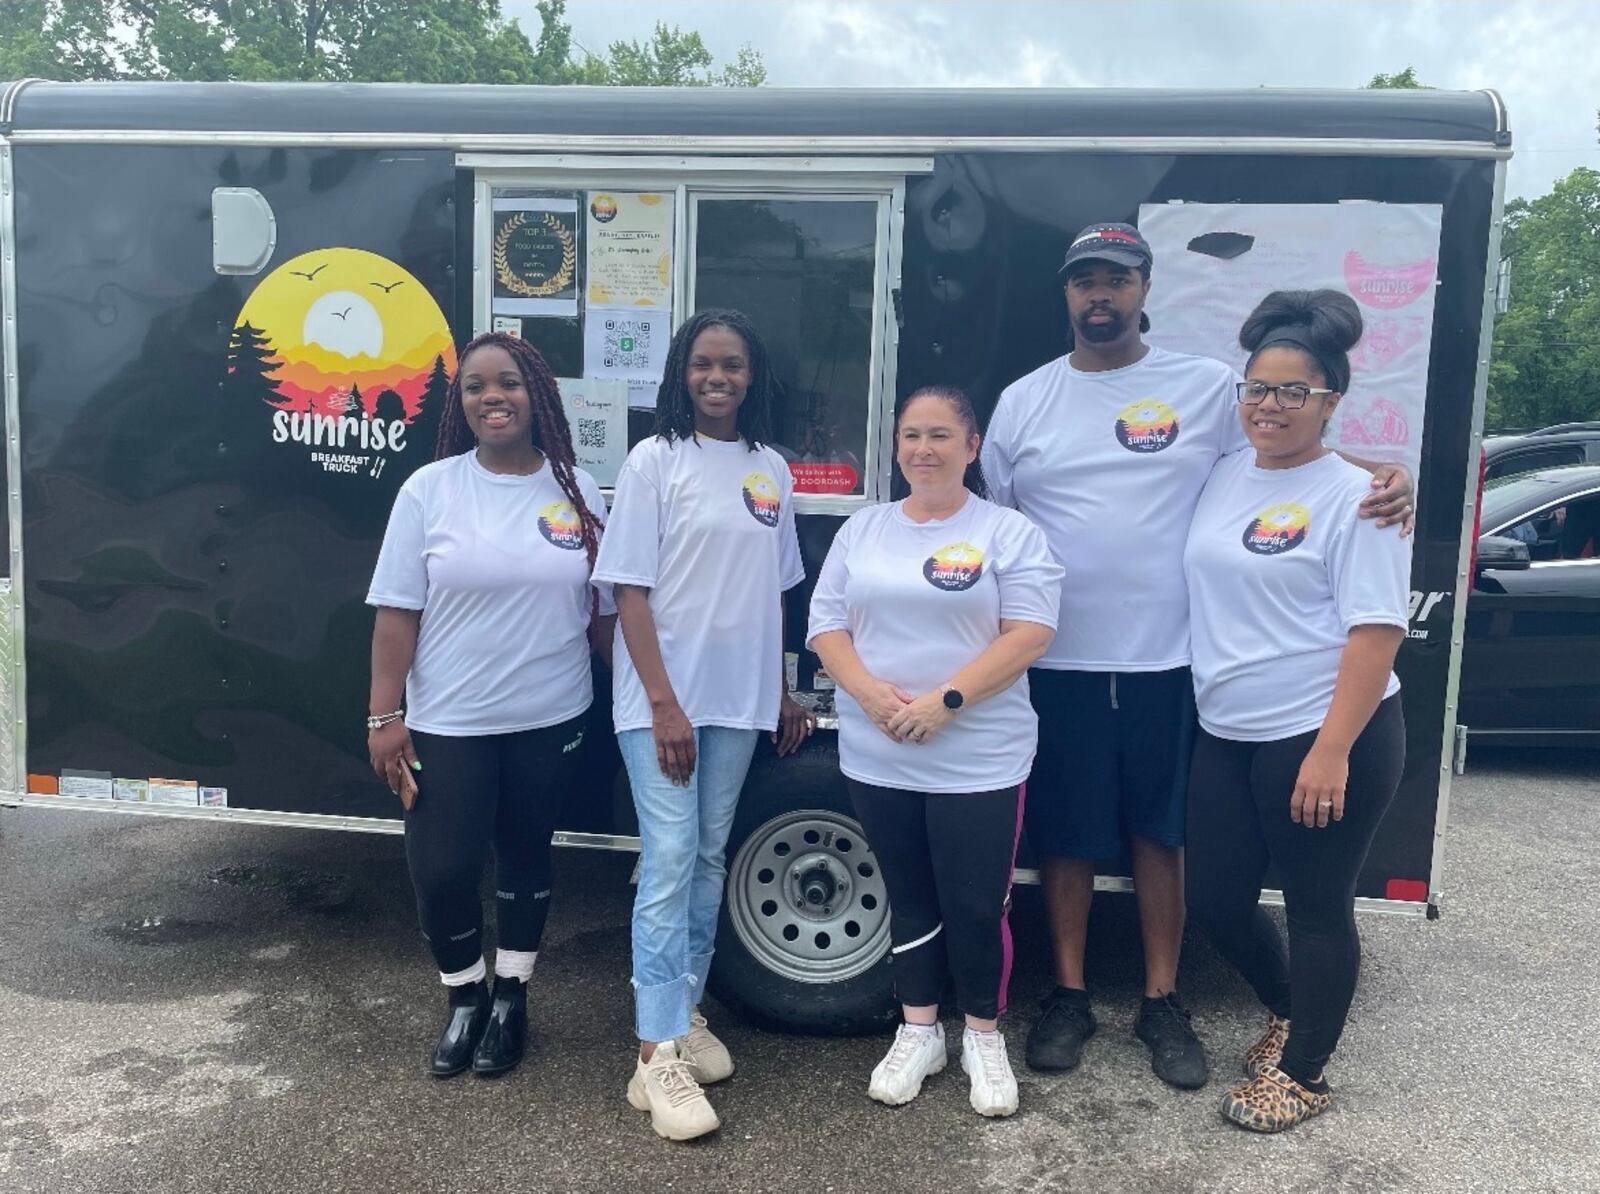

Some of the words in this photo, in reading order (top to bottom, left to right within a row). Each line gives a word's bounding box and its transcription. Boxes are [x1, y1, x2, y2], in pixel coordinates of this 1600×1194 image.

[1360, 277, 1416, 294] sunrise
[273, 410, 406, 452] sunrise
[311, 452, 370, 466] BREAKFAST
[322, 462, 358, 474] TRUCK
[801, 478, 851, 486] DOORDASH
[930, 570, 971, 582] sunrise
